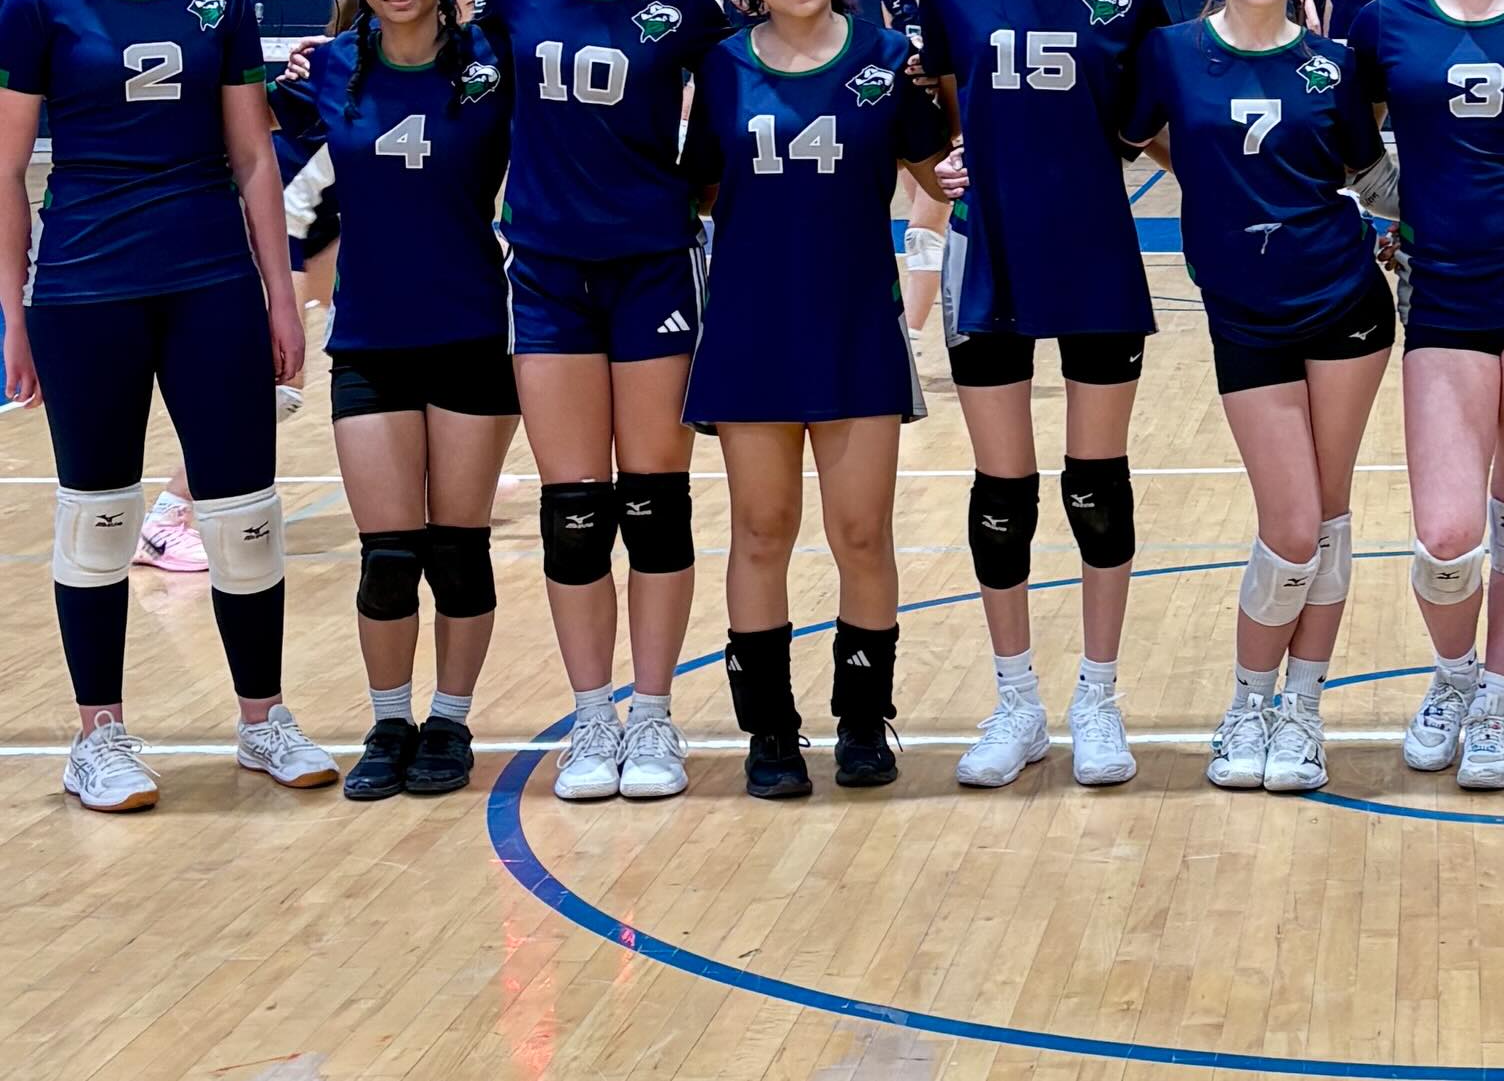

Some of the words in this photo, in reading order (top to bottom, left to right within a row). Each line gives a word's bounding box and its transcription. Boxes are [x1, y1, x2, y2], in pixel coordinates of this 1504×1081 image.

[123, 41, 183, 102] 2
[535, 41, 629, 105] 10
[989, 30, 1078, 91] 15
[375, 114, 431, 169] 4
[748, 114, 843, 174] 14
[1231, 99, 1282, 155] 7
